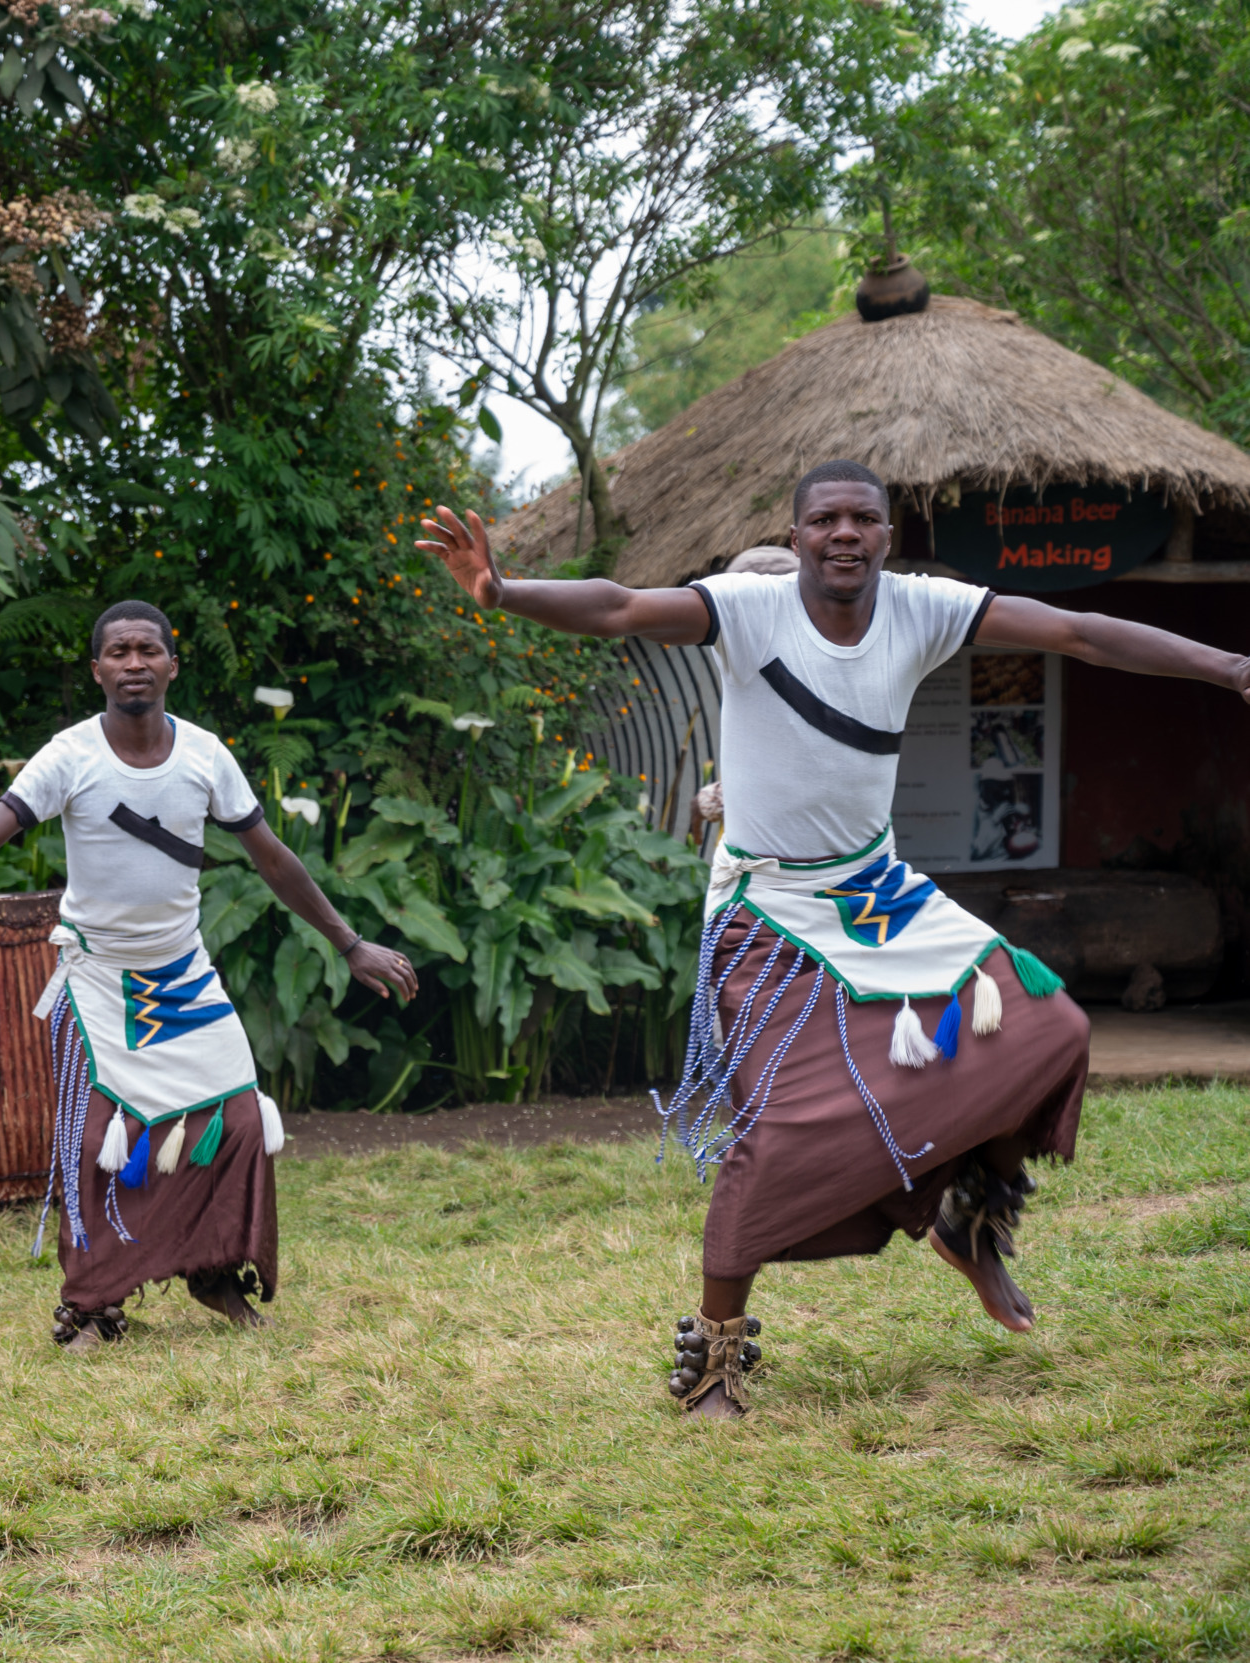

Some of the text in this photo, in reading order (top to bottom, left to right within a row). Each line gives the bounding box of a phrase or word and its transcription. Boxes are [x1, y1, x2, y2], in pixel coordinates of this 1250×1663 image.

[985, 498, 1122, 526] Banana Beer
[998, 541, 1112, 571] Making
